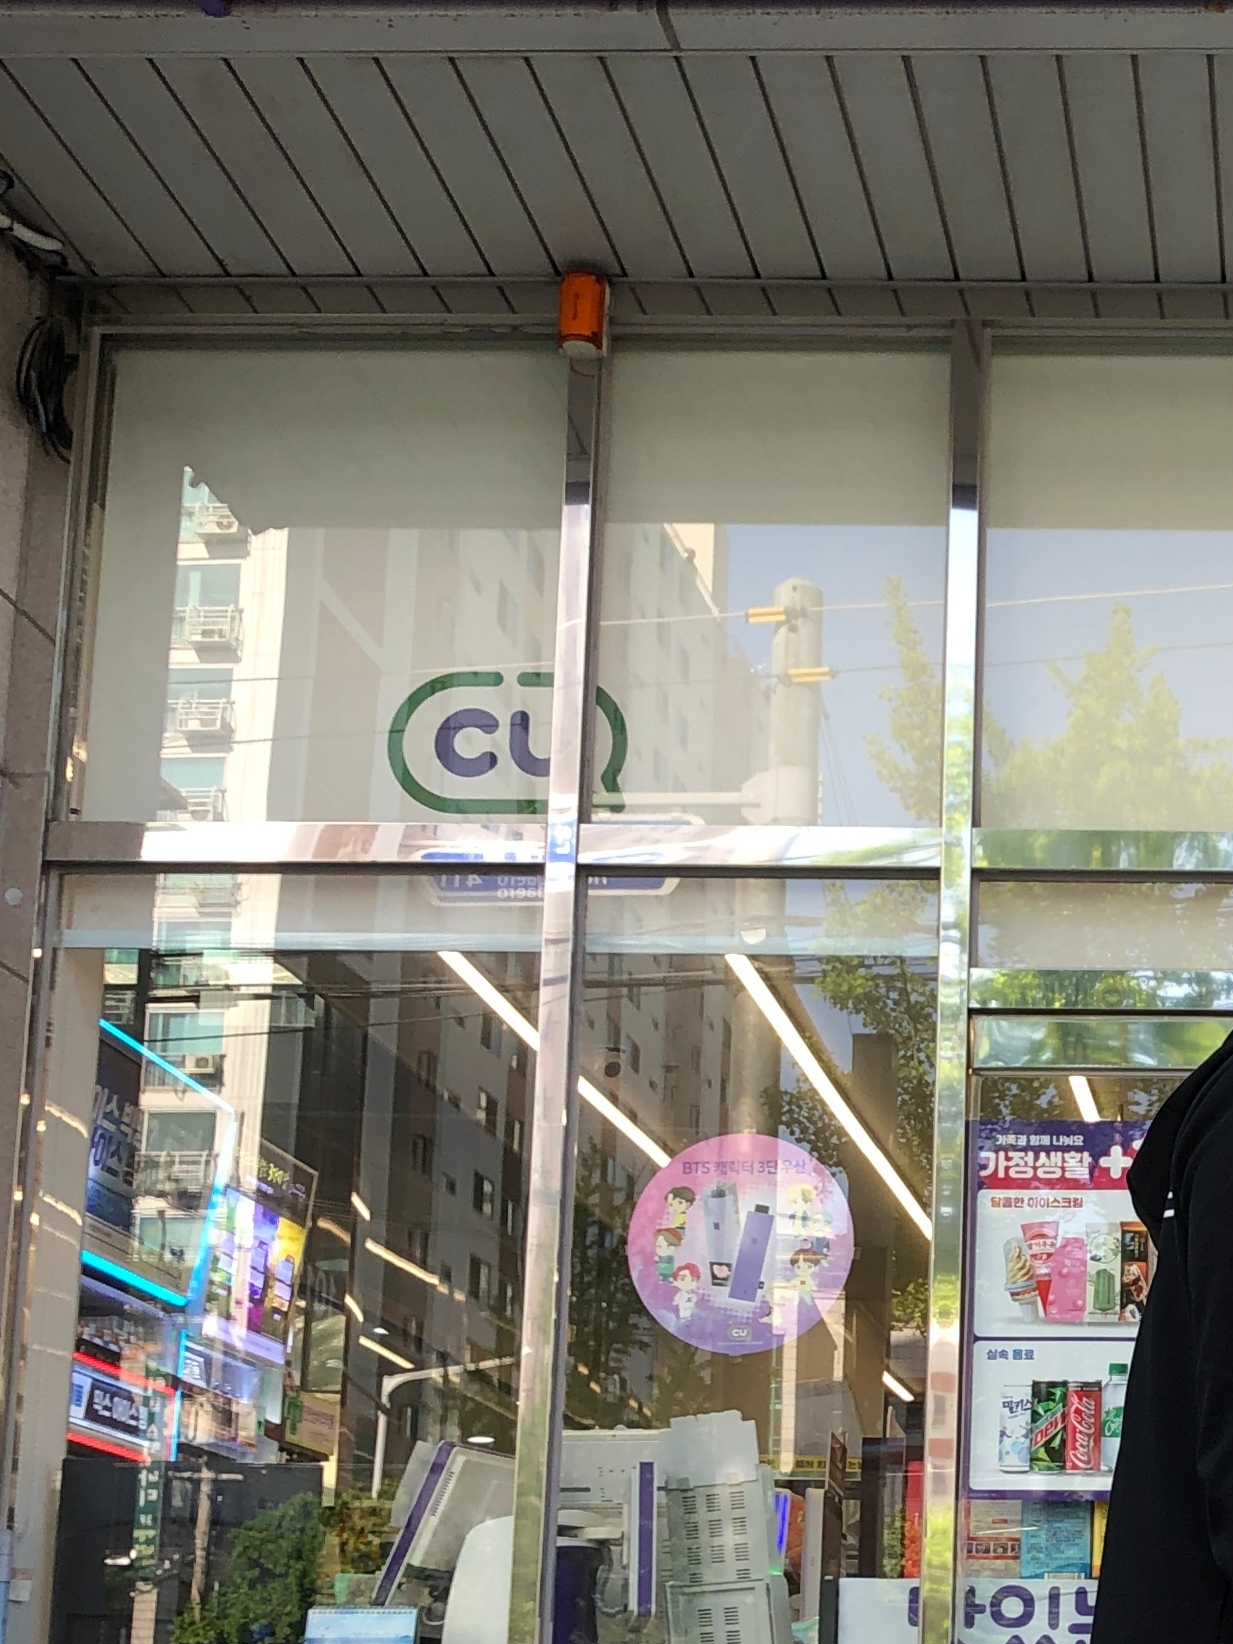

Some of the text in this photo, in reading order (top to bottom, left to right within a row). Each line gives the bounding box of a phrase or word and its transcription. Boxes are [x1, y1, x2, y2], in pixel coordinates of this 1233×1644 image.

[996, 1135, 1027, 1146] 가족과
[682, 1161, 711, 1175] BTS
[758, 1160, 778, 1174] 3단
[979, 1151, 1091, 1179] 가정생활
[731, 1328, 748, 1339] CU
[986, 1349, 1009, 1360] 실속
